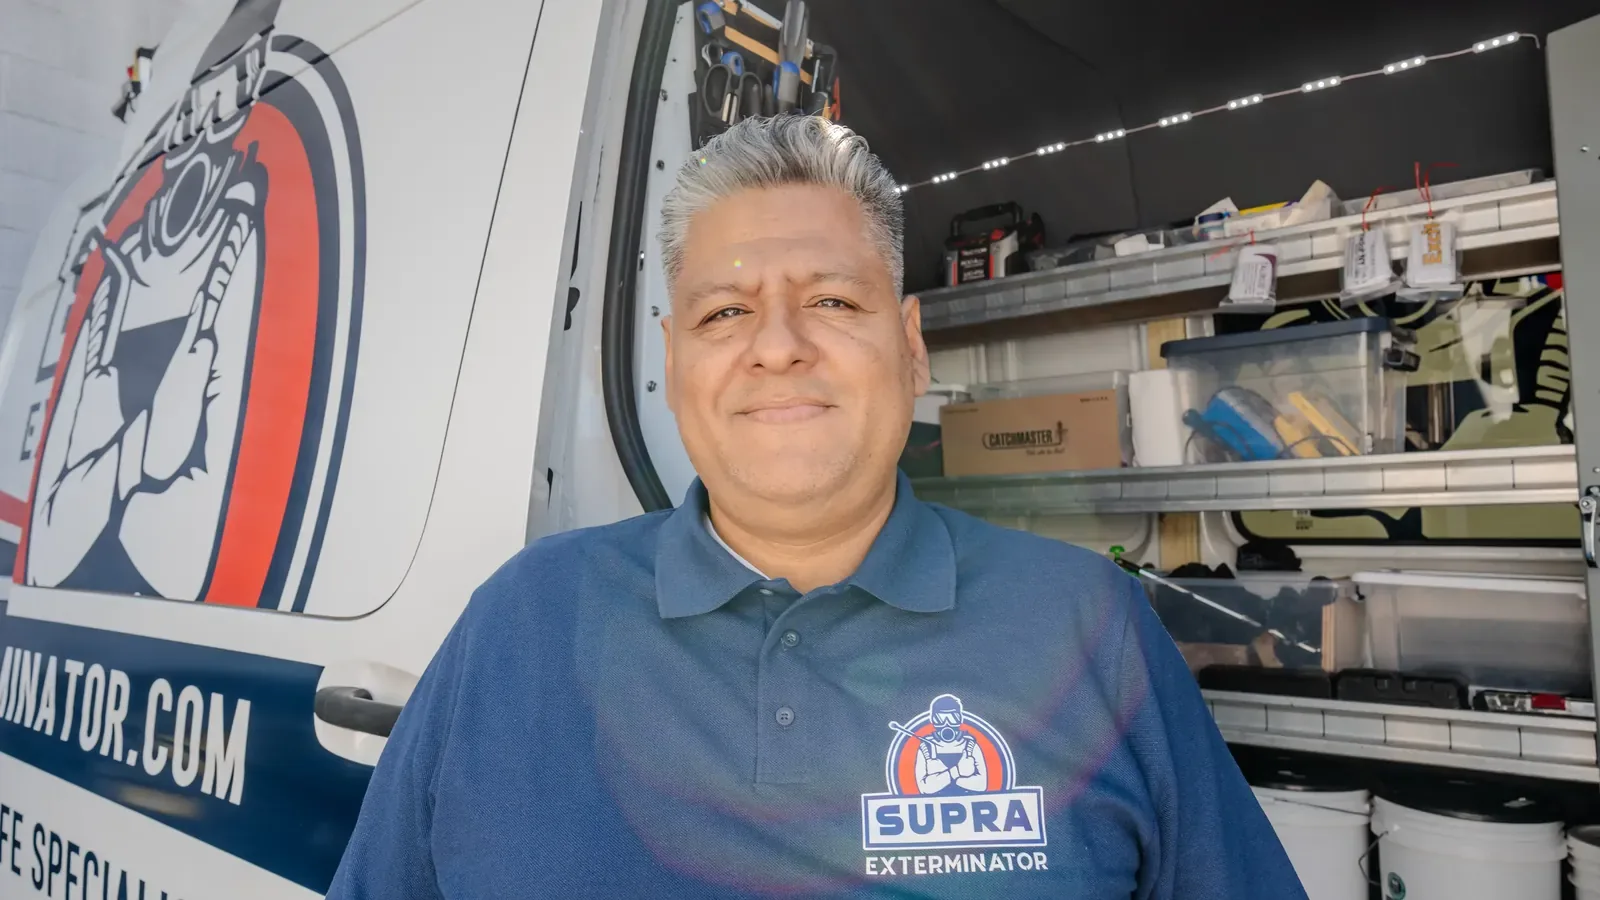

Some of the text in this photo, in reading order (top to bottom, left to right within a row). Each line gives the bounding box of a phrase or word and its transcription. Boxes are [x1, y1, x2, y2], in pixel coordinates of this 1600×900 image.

[988, 429, 1053, 447] CATCHMASTER
[875, 799, 1034, 836] SUPRA
[865, 851, 1049, 876] EXTERMINATOR
